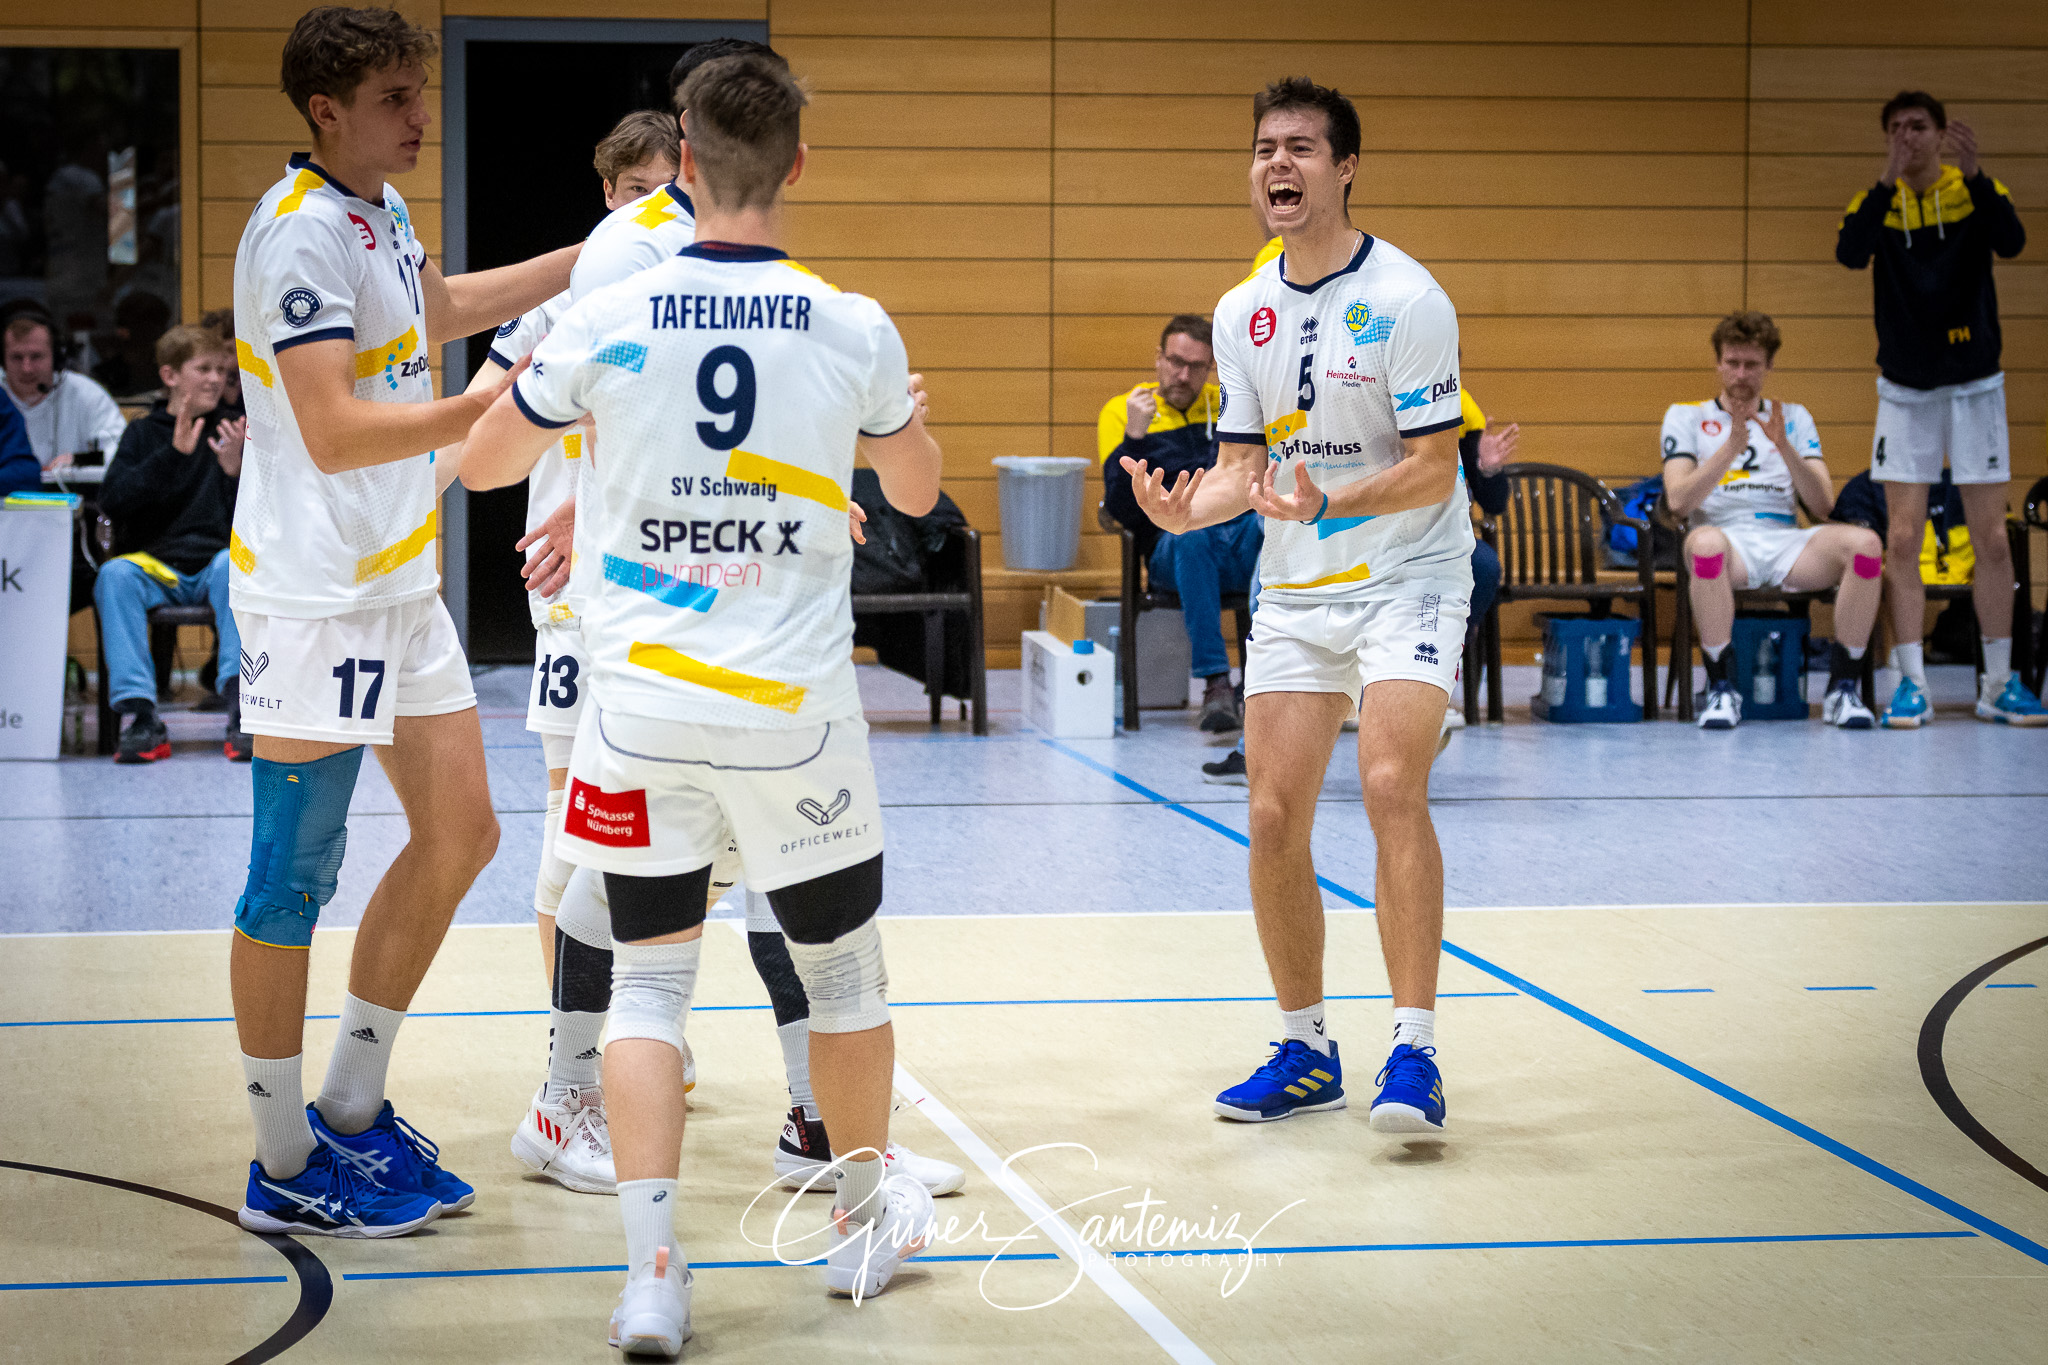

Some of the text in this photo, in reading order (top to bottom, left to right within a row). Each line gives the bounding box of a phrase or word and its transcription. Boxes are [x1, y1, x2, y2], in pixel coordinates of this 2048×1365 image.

[649, 294, 812, 332] TAFELMAYER
[1948, 326, 1972, 345] FH
[695, 344, 757, 452] 9
[1297, 353, 1316, 412] 5
[1431, 373, 1458, 403] puls
[1742, 446, 1760, 471] 2
[1876, 436, 1886, 467] 4
[671, 476, 778, 502] SV Schwaig
[640, 518, 766, 555] SPECK
[641, 561, 761, 593] pumpen
[1414, 654, 1439, 665] errea
[332, 657, 386, 720] 17
[538, 653, 580, 709] 13
[780, 823, 870, 854] OFFICEWELT
[350, 1031, 379, 1044] adidas
